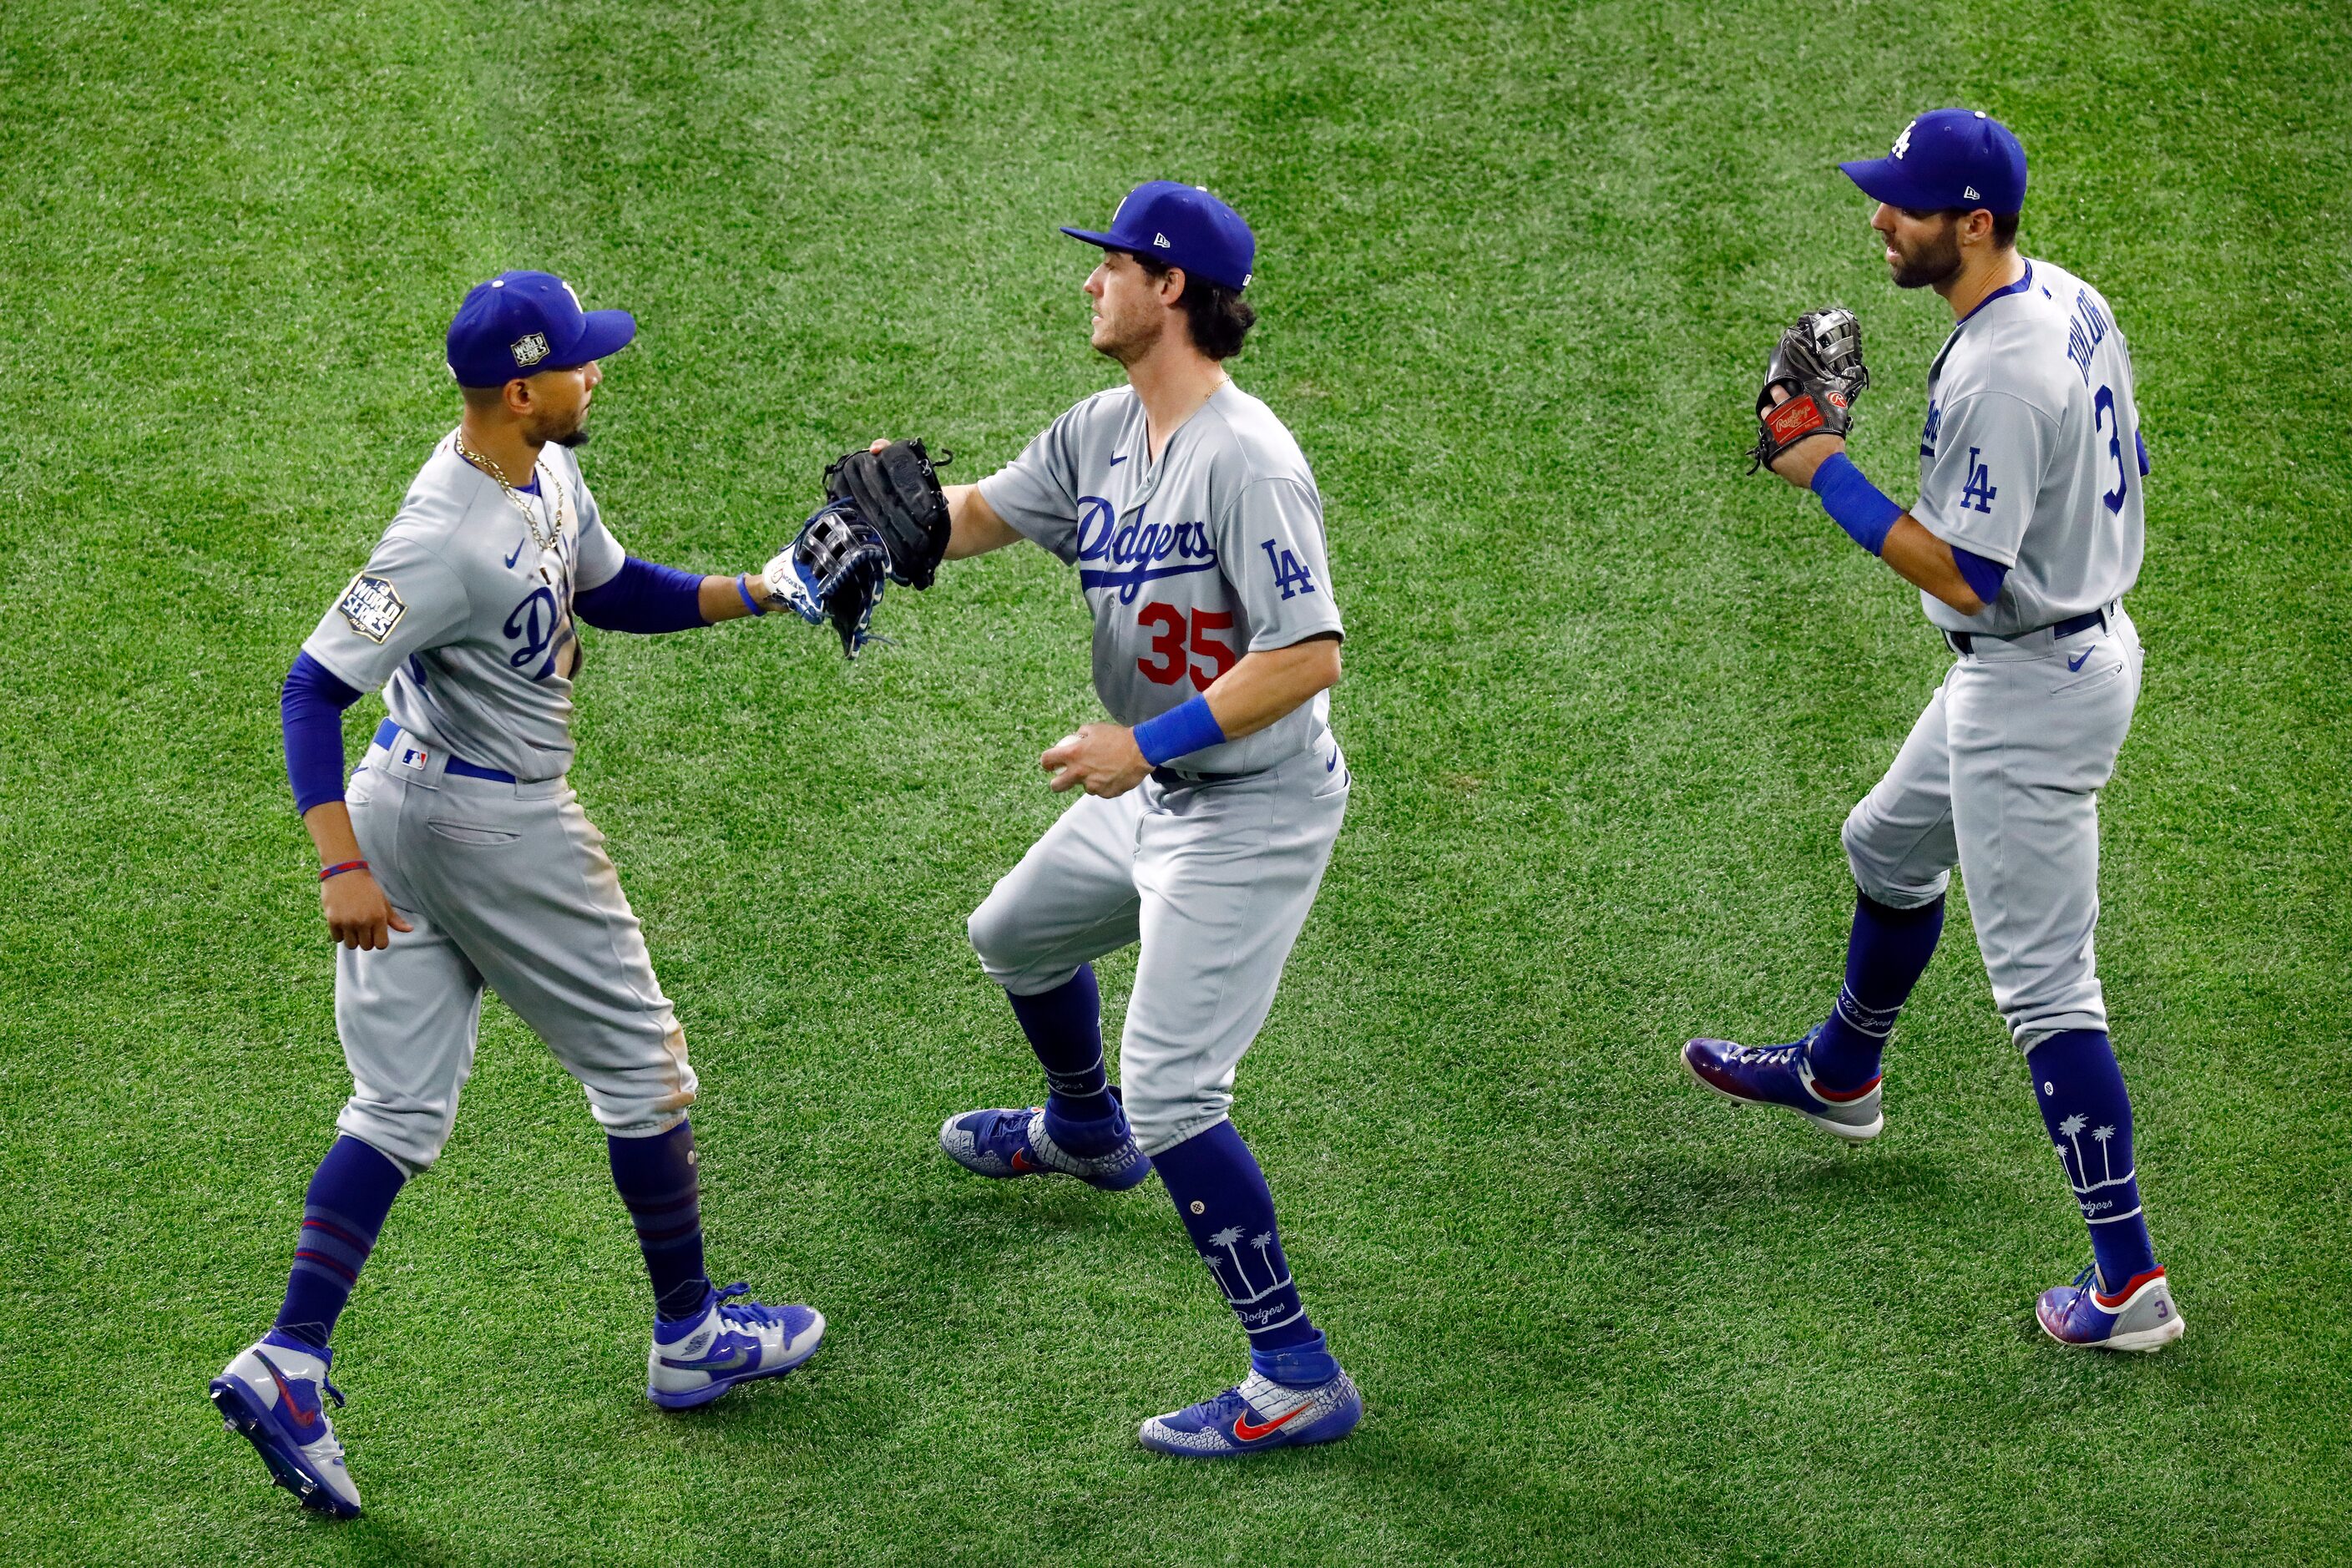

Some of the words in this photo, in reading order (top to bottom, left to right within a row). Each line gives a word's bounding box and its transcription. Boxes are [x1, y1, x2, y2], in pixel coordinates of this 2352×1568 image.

[513, 336, 544, 356] WORLD
[517, 345, 547, 364] SERIES
[1776, 406, 1811, 432] Rawlings
[2093, 384, 2127, 517] 3
[1959, 446, 1998, 514] LA
[1261, 539, 1316, 601] LA
[342, 593, 392, 636] SERIES
[352, 579, 401, 622] WORLD
[1137, 601, 1236, 692] 35
[1236, 1302, 1285, 1325] Dodgers
[2154, 1299, 2168, 1319] 3
